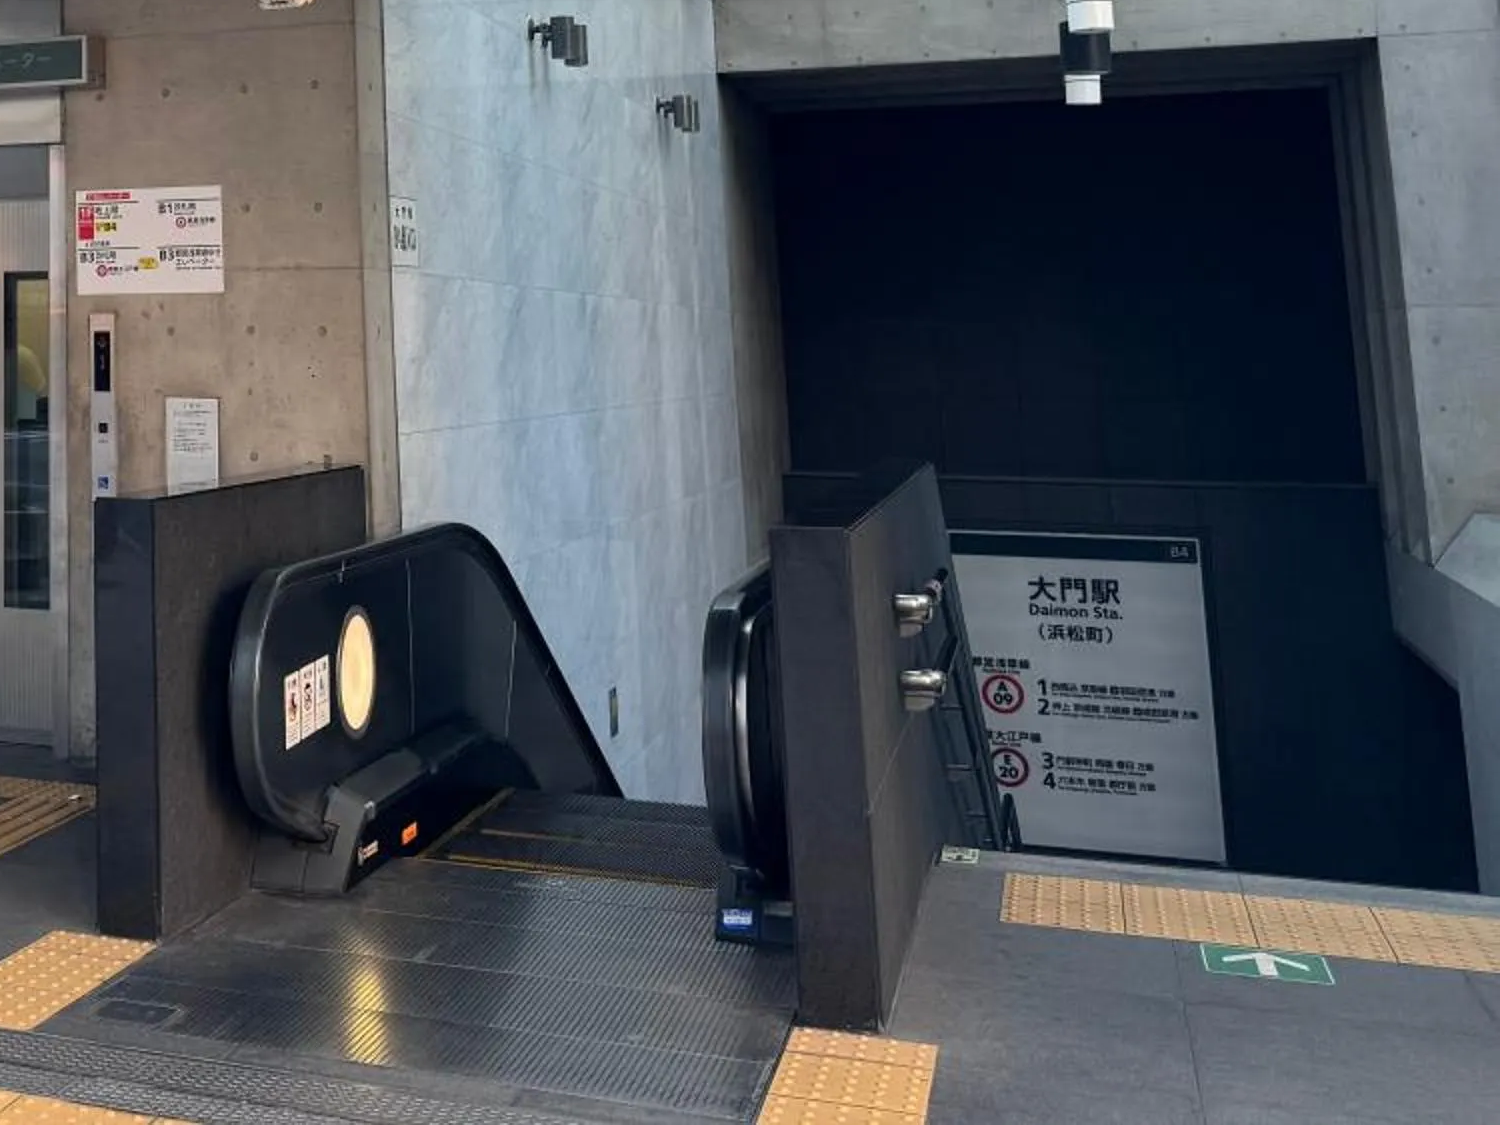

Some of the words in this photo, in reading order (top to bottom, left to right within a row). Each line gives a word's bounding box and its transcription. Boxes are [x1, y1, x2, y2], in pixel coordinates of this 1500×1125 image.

[1028, 576, 1120, 605] 大門駅
[1029, 603, 1089, 618] Daimon
[1093, 606, 1124, 620] Sta.
[996, 681, 1008, 692] A
[1037, 679, 1047, 696] 1
[993, 692, 1013, 706] 09
[1037, 698, 1051, 716] 2
[1042, 752, 1054, 770] 3
[999, 766, 1019, 779] 20
[1043, 773, 1056, 789] 4
